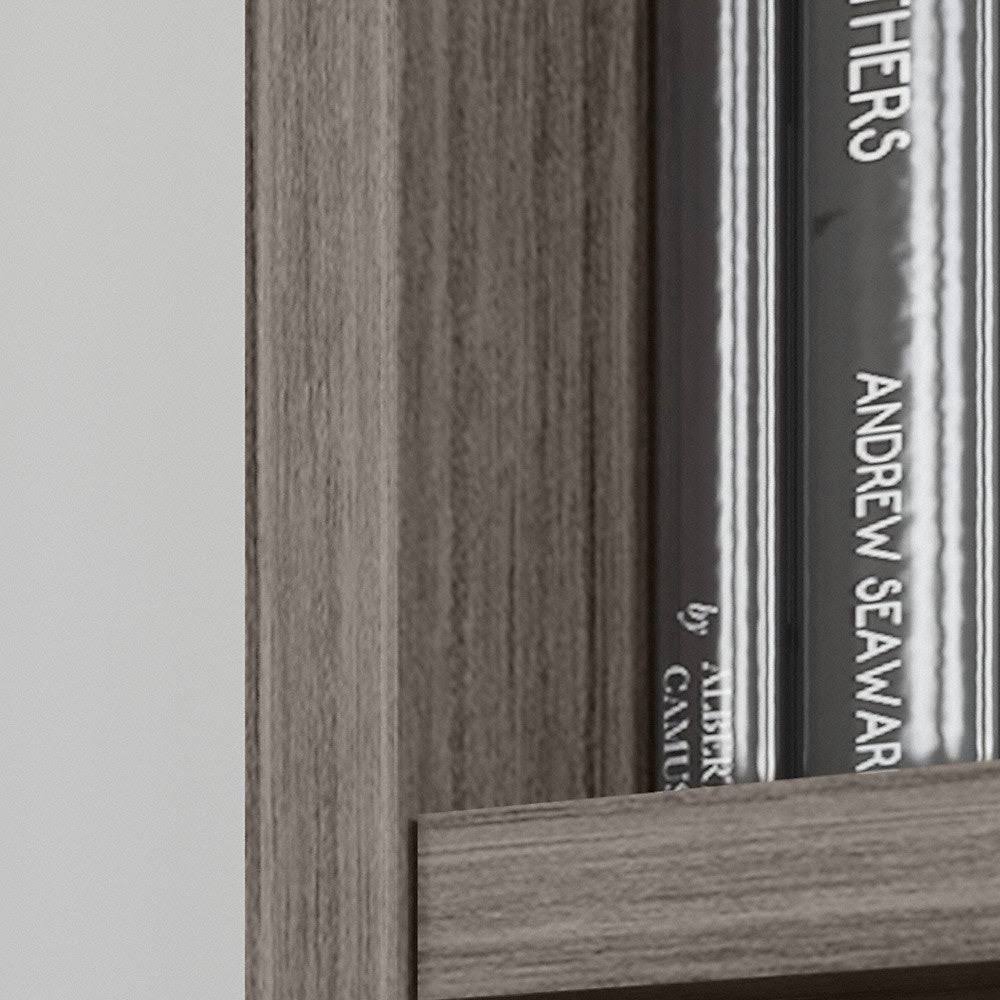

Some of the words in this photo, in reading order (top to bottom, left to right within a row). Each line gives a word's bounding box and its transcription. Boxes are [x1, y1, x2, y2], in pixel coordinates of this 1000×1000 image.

[855, 371, 902, 561] ANDREW
[677, 602, 720, 636] by
[701, 661, 733, 785] ALBER
